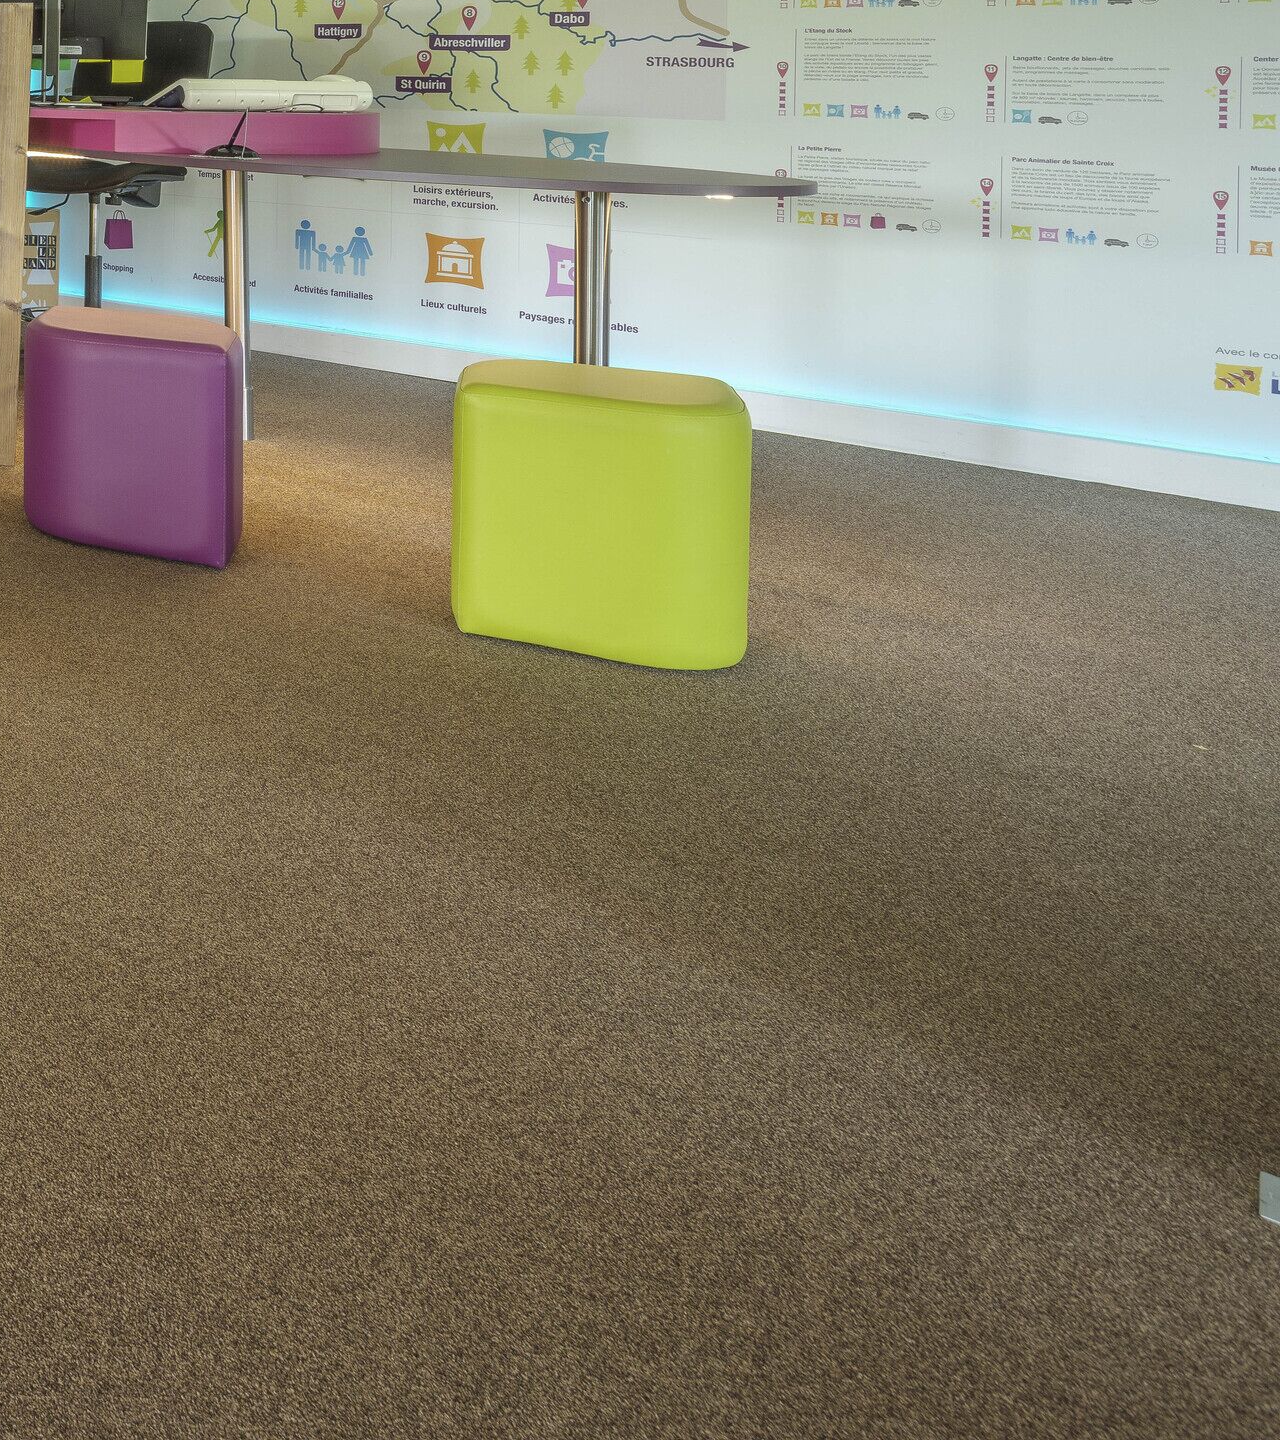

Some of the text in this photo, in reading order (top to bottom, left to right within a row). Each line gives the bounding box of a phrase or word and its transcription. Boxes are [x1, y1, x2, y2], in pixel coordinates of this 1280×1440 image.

[334, 0, 343, 8] 12
[466, 9, 473, 17] 8
[554, 13, 585, 25] Dabo
[317, 25, 359, 39] Hattigny
[433, 36, 506, 49] Abreschviller
[421, 52, 428, 61] 9
[645, 56, 735, 69] STRASBOURG
[1012, 55, 1042, 63] Langatte
[400, 79, 446, 92] St Quirin
[198, 170, 221, 182] Temps
[413, 185, 494, 200] Loisirs extérieurs,
[413, 197, 499, 211] marche, excursion.
[533, 193, 575, 205] Activités
[38, 247, 56, 258] LE
[103, 262, 134, 274] Shopping
[193, 273, 225, 284] Accessib
[294, 284, 373, 301] Activités familialles
[421, 299, 487, 315] Lieux culturels
[519, 311, 565, 325] Paysages
[1216, 347, 1246, 356] Avec
